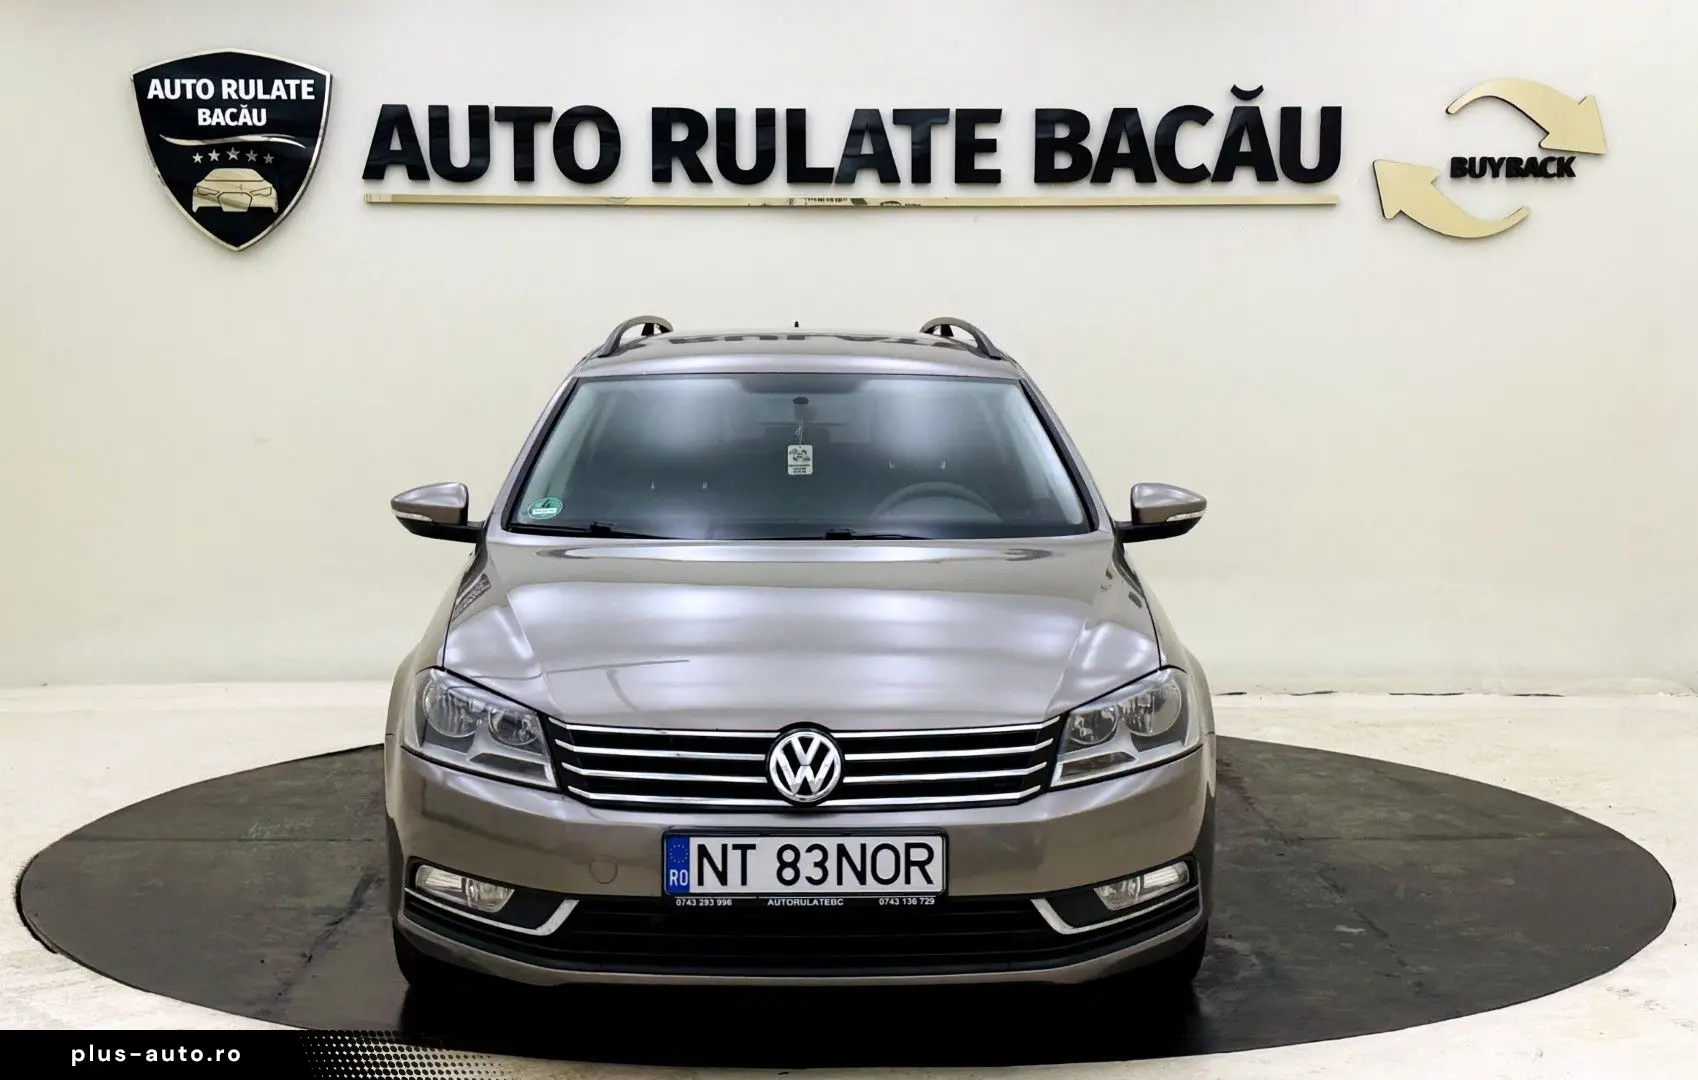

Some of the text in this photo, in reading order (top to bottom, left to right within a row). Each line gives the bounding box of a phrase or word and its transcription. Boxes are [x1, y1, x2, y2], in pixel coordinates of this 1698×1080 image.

[147, 78, 315, 100] AUTO RULATE
[197, 104, 267, 127] BACĂU
[362, 84, 1343, 185] AUTO RULATE BACĂU
[1449, 156, 1576, 179] BUYBACK
[697, 842, 935, 886] NT 83NOR
[669, 869, 689, 887] RO
[675, 898, 697, 907] 0743
[767, 898, 844, 907] AUTORULATEBC
[878, 897, 935, 906] 0743 136 729
